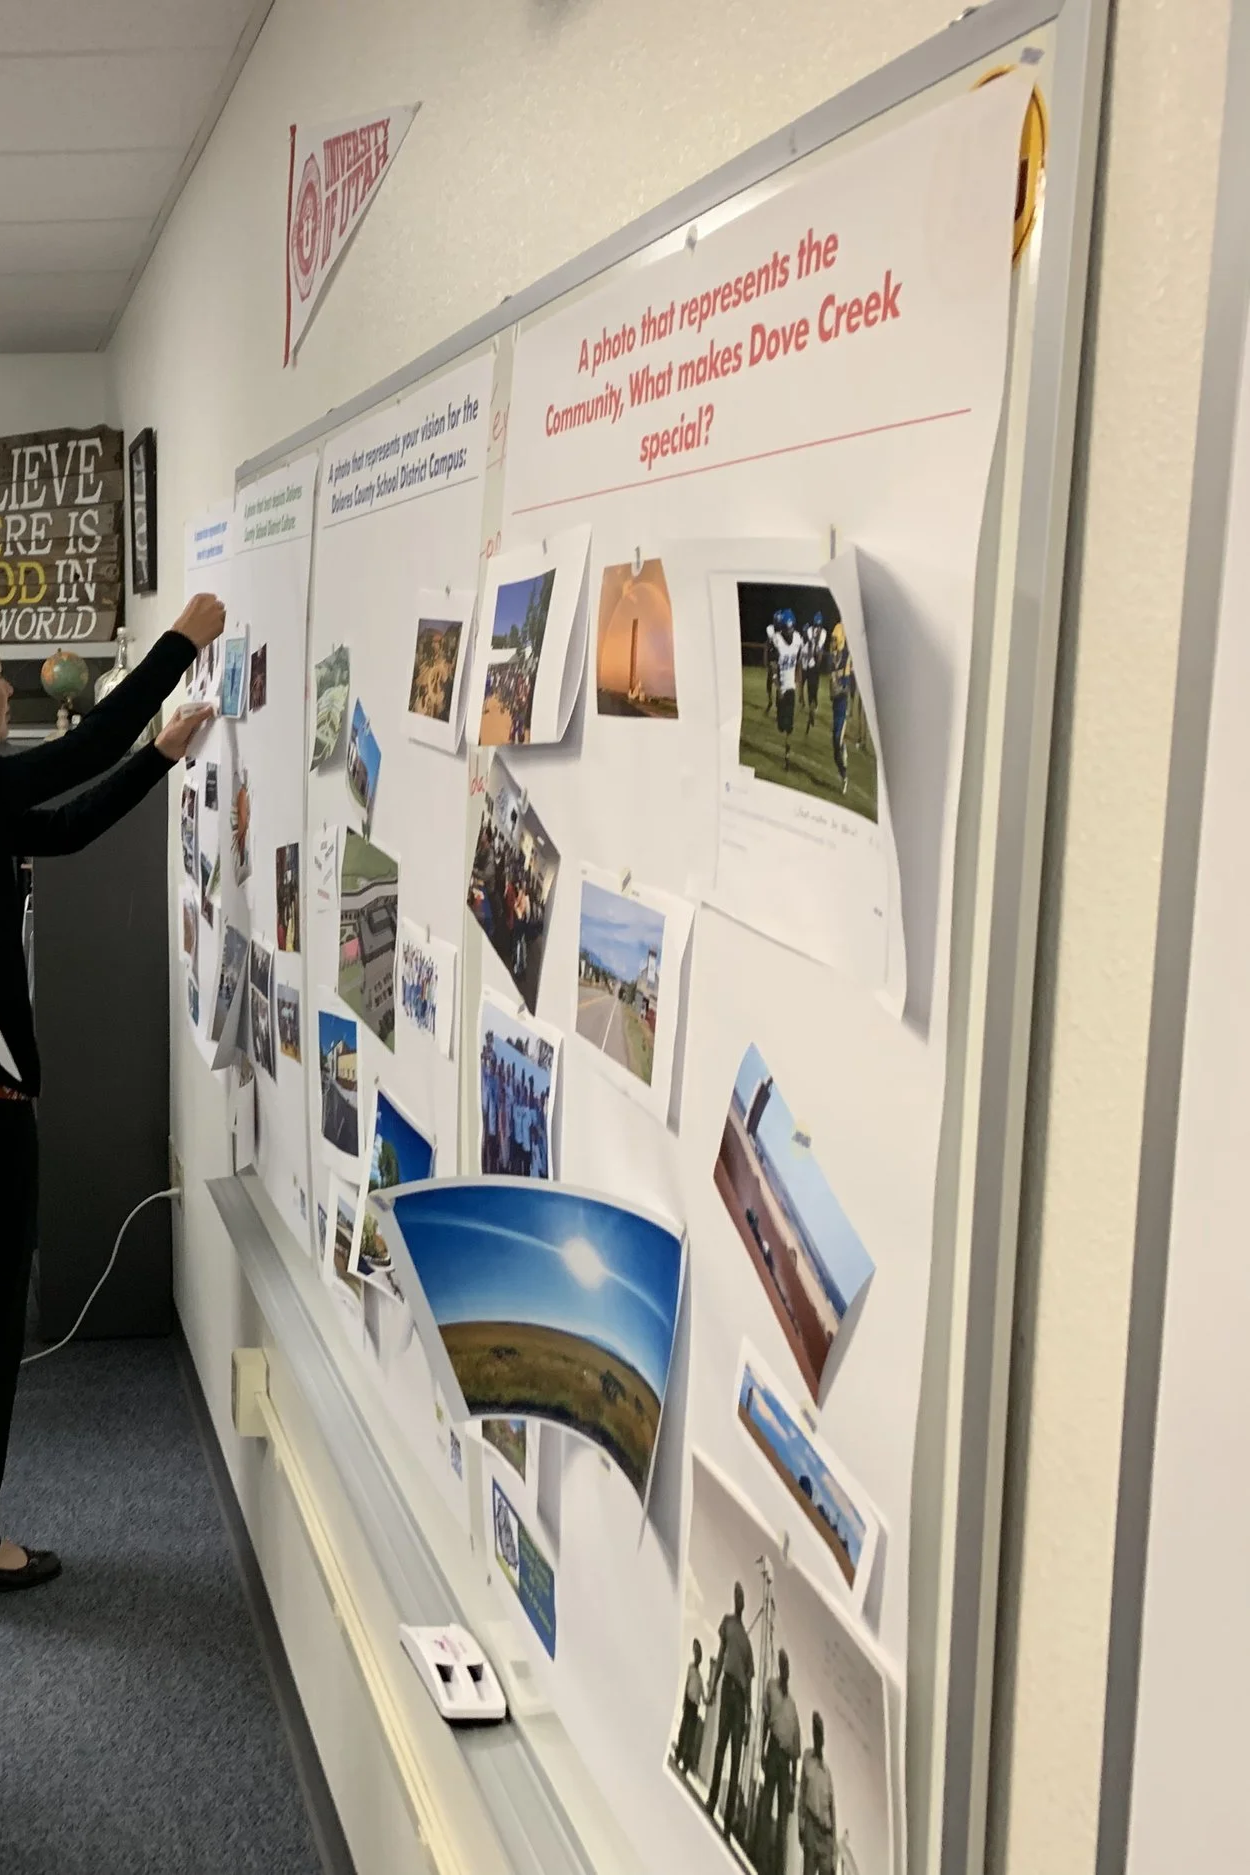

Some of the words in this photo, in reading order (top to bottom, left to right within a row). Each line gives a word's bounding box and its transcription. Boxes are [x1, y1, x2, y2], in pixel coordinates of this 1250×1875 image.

[323, 117, 391, 192] UNIVERSITY
[321, 188, 338, 270] OF
[338, 153, 390, 238] UTAH
[578, 338, 589, 373] A
[592, 327, 636, 377] photo
[640, 302, 675, 347] that
[678, 250, 790, 333] represents
[797, 227, 839, 280] the
[545, 381, 626, 437] Community,
[628, 361, 674, 407] What
[677, 339, 743, 389] makes
[749, 322, 810, 367] Dove
[817, 269, 903, 342] Creek
[328, 464, 334, 484] A
[334, 459, 350, 487] photo
[351, 450, 365, 473] that
[365, 434, 400, 472] represents
[401, 428, 419, 458] your
[421, 412, 446, 442] vision
[447, 402, 461, 431] for
[462, 393, 479, 424] the
[639, 403, 715, 471] special?
[331, 489, 353, 514] Dolores
[354, 482, 375, 506] County
[376, 465, 399, 498] School
[400, 458, 428, 489] District
[429, 447, 467, 480] Campus:
[65, 508, 102, 556] IS
[55, 557, 97, 603] IN
